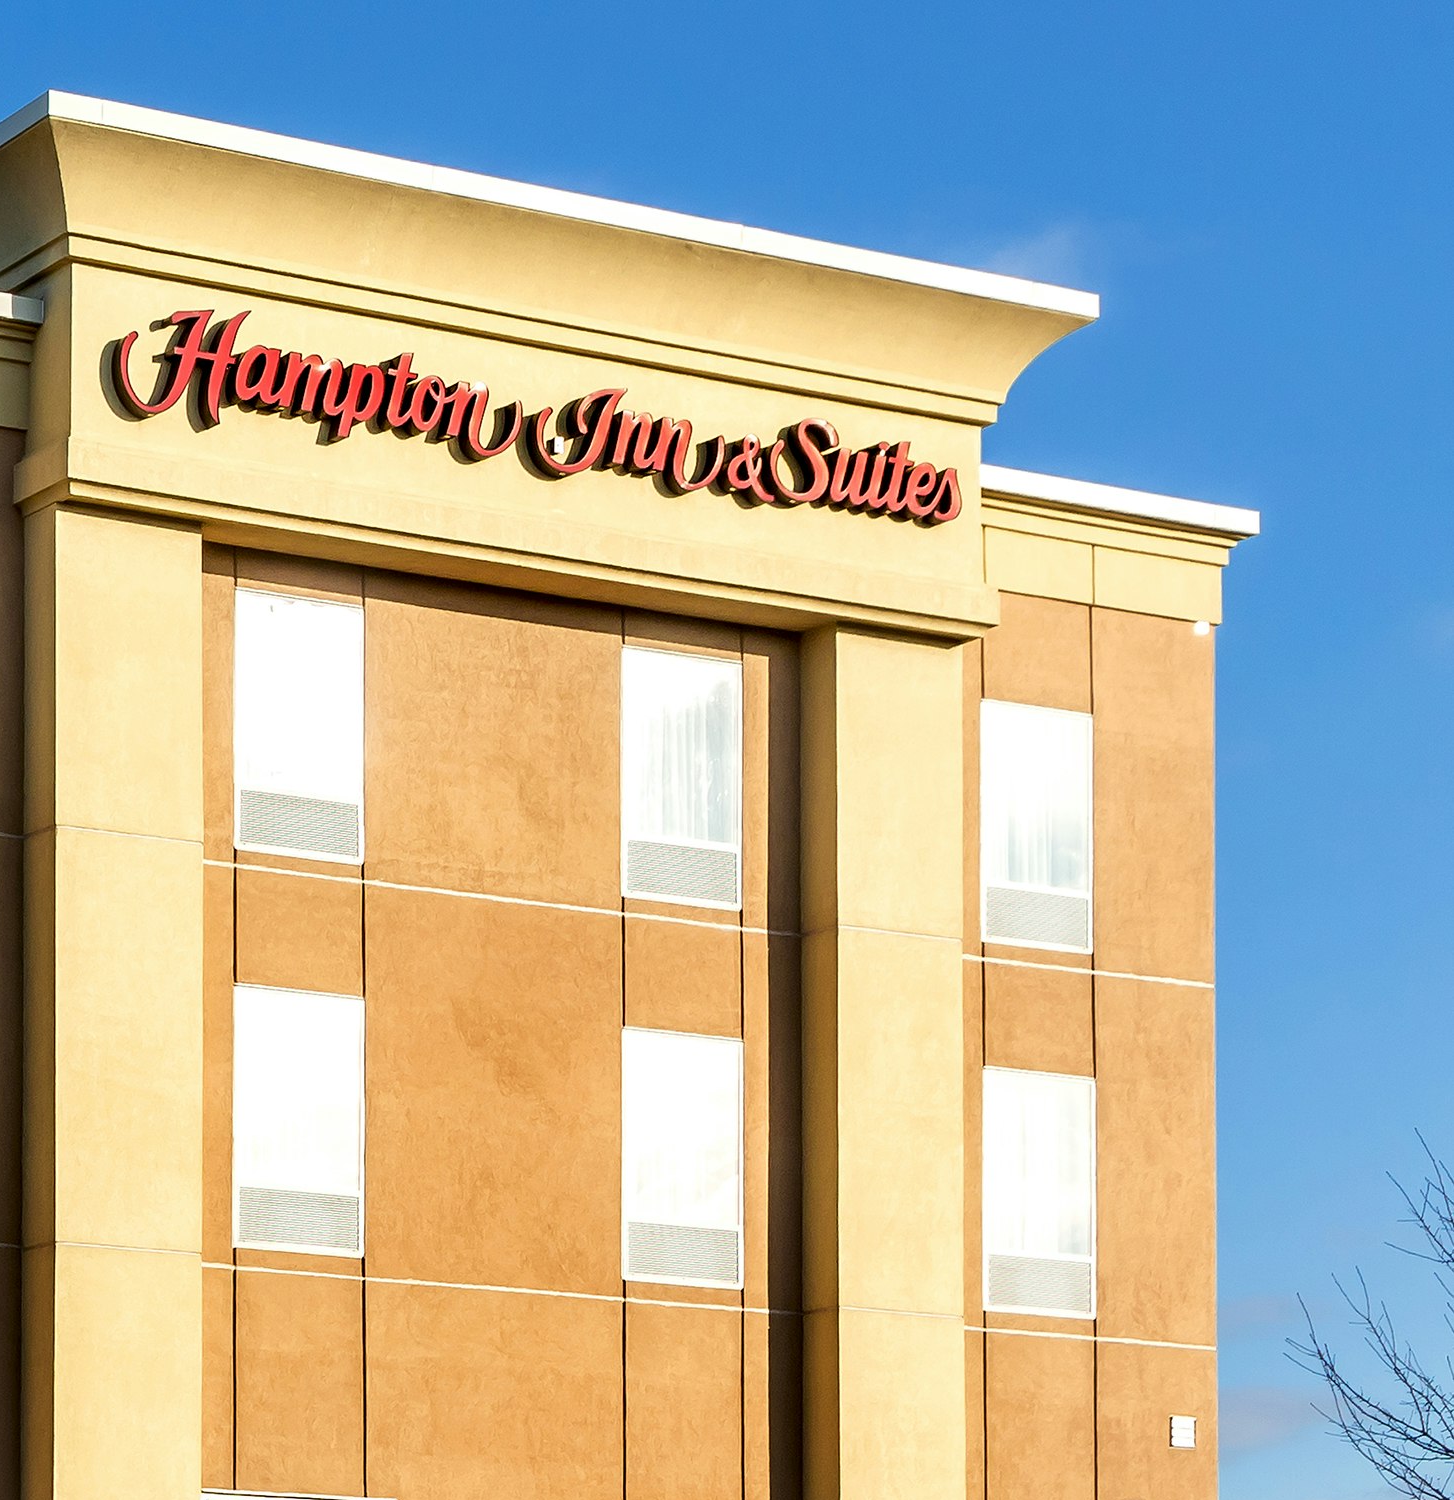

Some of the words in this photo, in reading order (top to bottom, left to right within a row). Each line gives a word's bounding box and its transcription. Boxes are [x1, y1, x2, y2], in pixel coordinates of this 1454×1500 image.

[114, 309, 523, 458] Hampton
[532, 387, 725, 491] Inn
[726, 433, 776, 502] &
[770, 417, 962, 522] Suites
